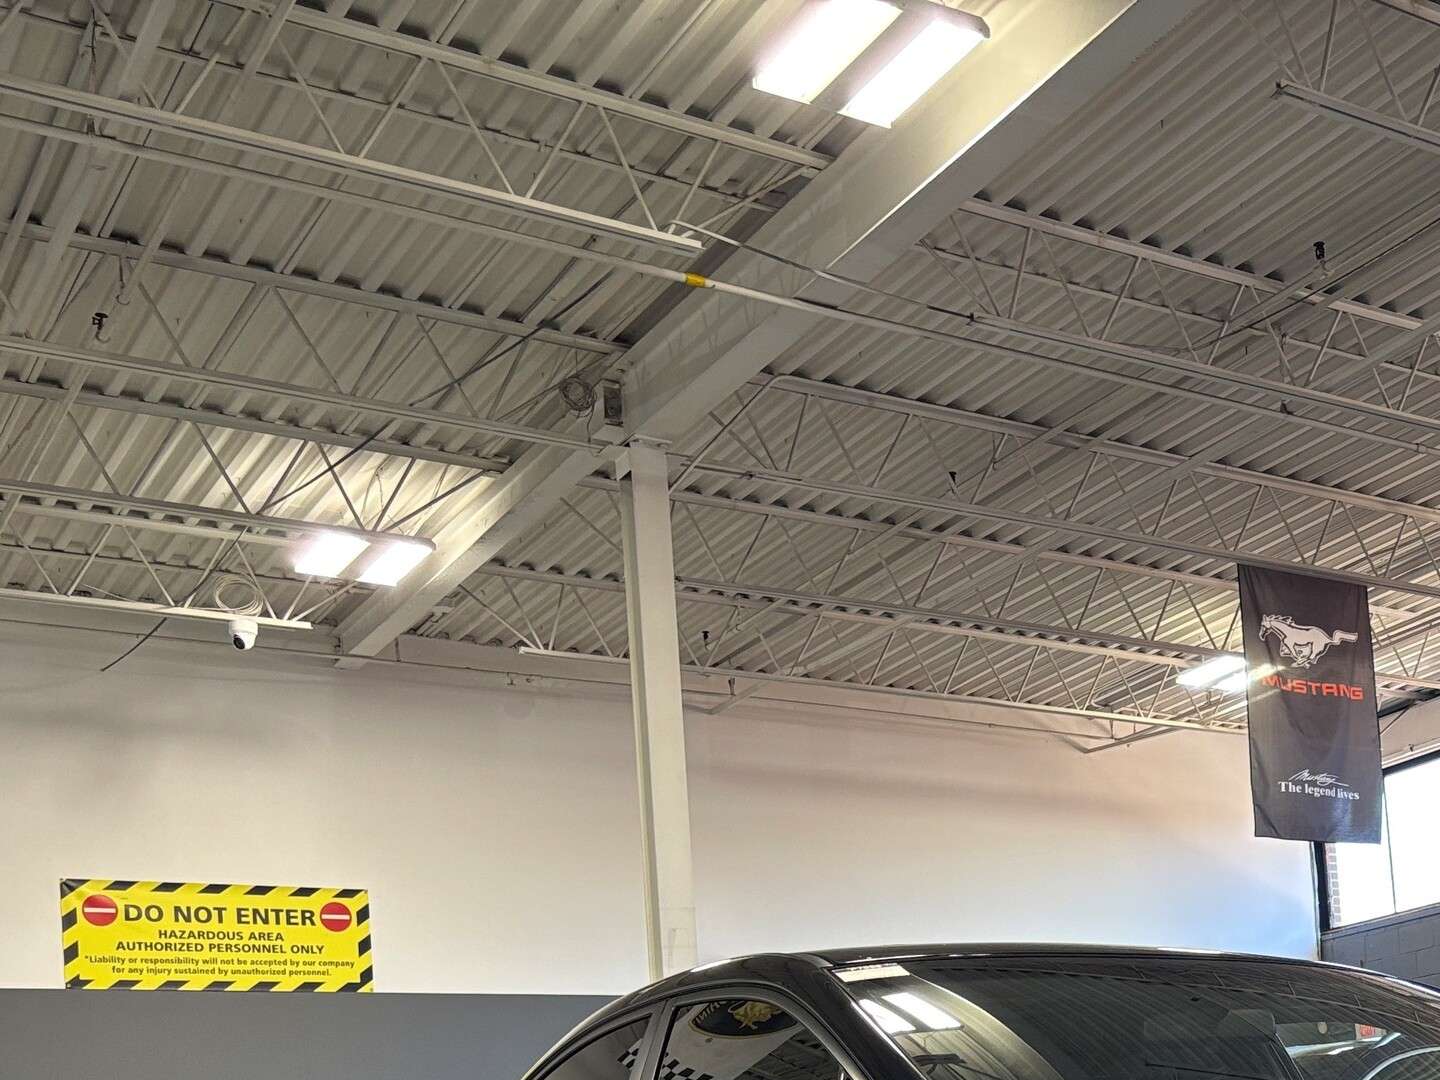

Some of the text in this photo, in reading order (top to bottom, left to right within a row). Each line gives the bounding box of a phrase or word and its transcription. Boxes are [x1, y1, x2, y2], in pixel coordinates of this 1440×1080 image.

[1262, 675, 1364, 701] MUSTANG
[1278, 781, 1360, 800] The legend lives
[124, 904, 316, 927] DO NOT ENTER
[158, 929, 284, 942] HAZARDOUS AREA
[116, 941, 325, 955] AUTHORIZED PERSONNEL ONLY
[140, 955, 199, 966] responsibility
[202, 957, 218, 965] will
[220, 958, 235, 966] not
[237, 958, 248, 966] be
[250, 958, 288, 967] accepted
[289, 959, 300, 968] by
[318, 960, 355, 968] company
[128, 967, 144, 975] any
[146, 966, 172, 975] injury
[174, 966, 216, 975] sustained
[218, 967, 229, 976] by
[231, 968, 287, 976] unauthorized
